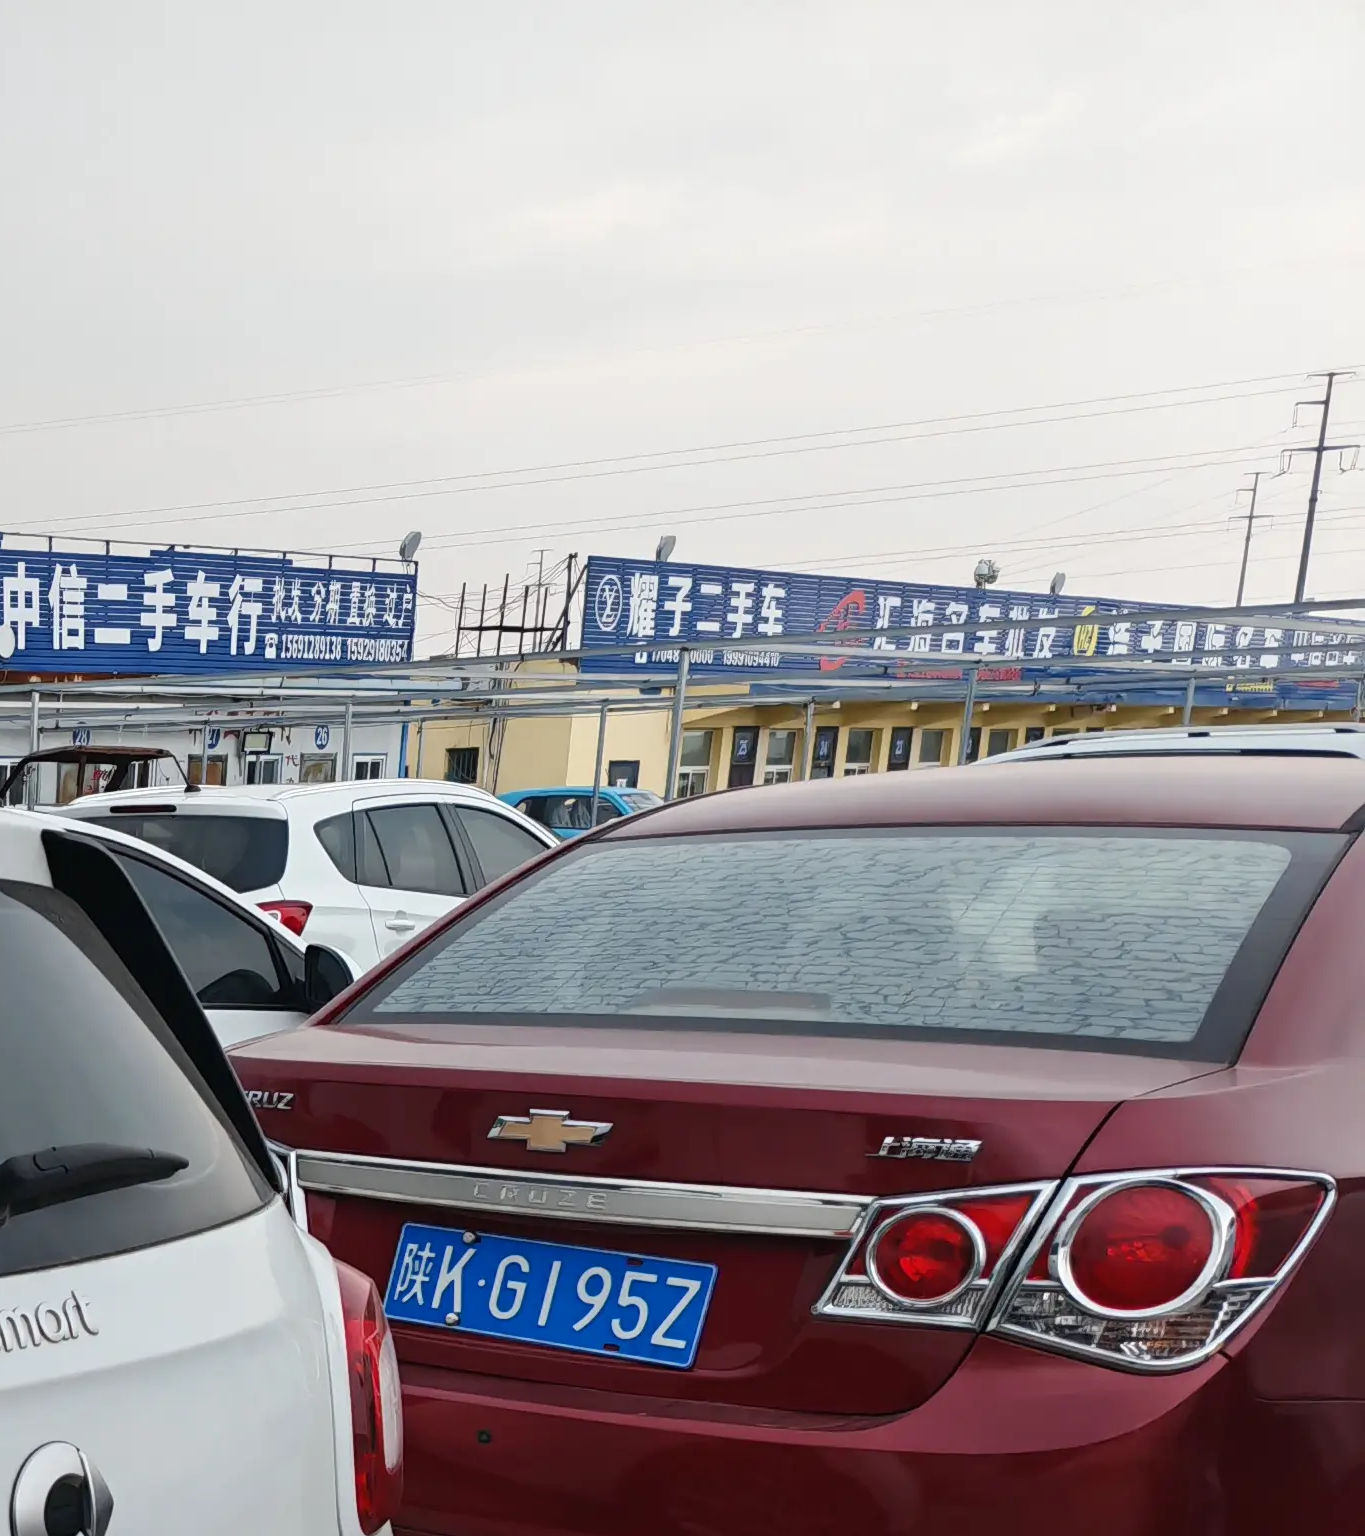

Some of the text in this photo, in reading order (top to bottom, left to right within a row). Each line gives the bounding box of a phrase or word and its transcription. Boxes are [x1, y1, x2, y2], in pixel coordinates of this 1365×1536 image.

[3, 561, 263, 656] 中信二手车行
[309, 580, 342, 625] 分期
[281, 634, 341, 661] 15691289138
[316, 727, 328, 746] 26
[243, 1090, 295, 1110] RUZ
[473, 1180, 608, 1210] CRUZE
